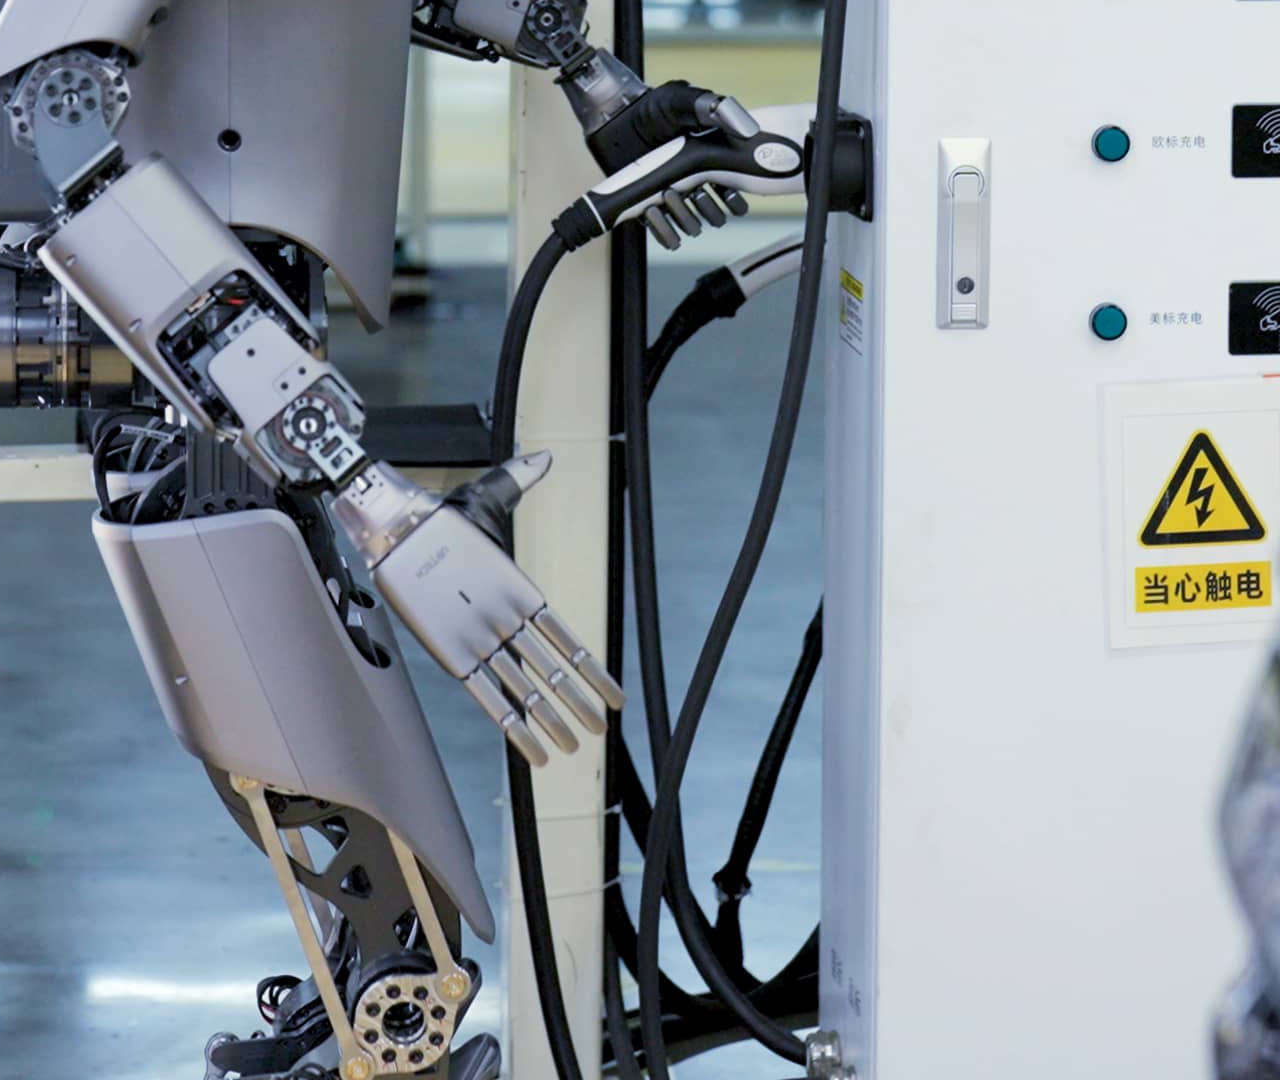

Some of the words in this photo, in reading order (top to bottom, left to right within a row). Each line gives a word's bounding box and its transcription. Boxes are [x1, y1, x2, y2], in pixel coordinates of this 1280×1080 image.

[1152, 136, 1206, 149] 欧标充电
[1143, 569, 1264, 605] 当心触电
